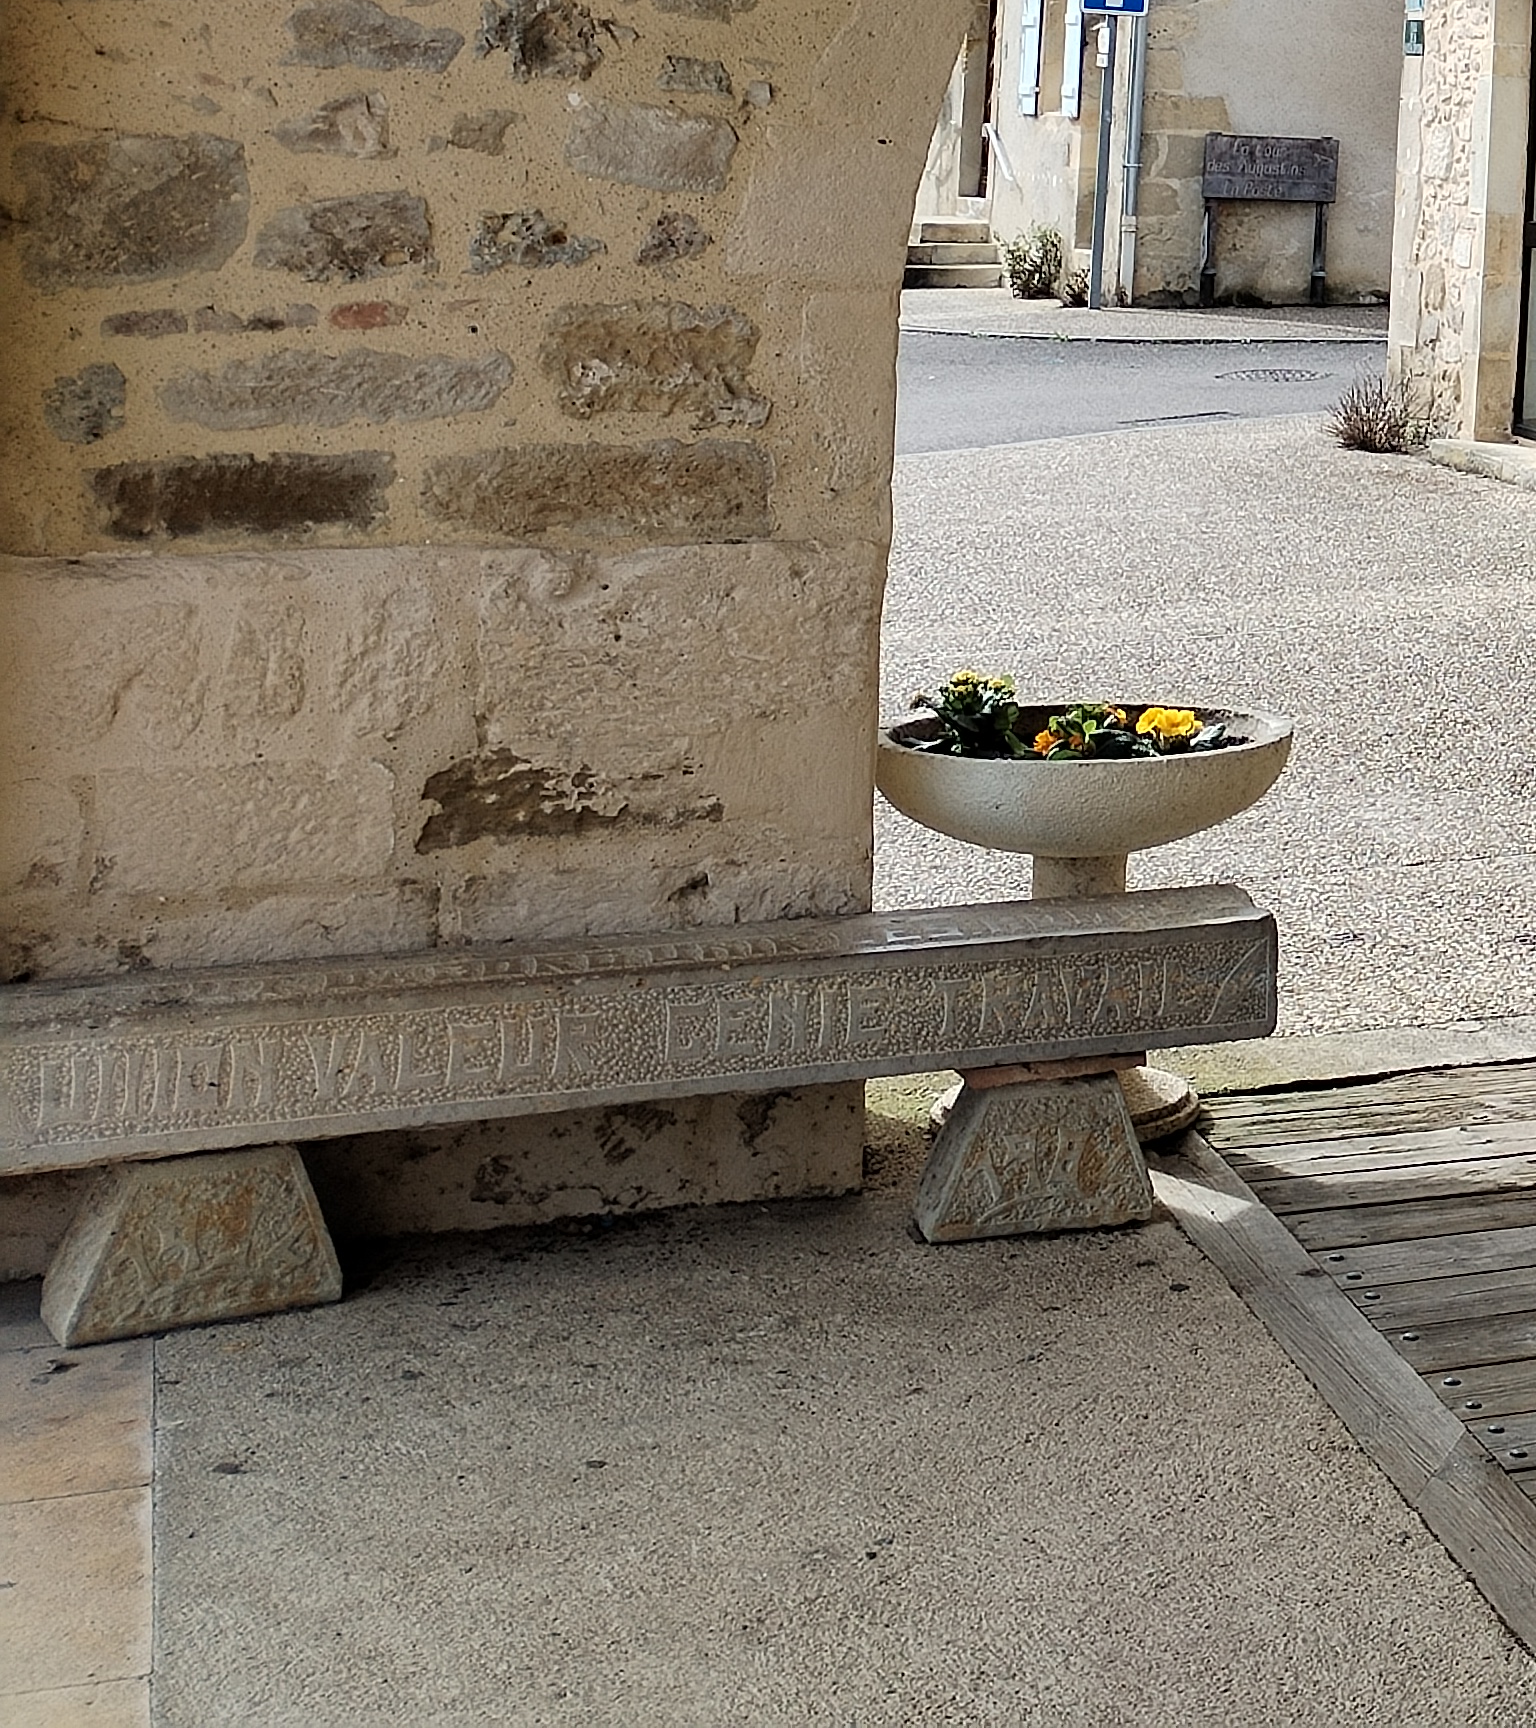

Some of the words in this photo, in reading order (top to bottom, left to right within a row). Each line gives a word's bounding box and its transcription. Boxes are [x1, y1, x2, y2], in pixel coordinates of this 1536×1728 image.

[1206, 158, 1231, 173] des
[1237, 159, 1307, 178] Augustins
[37, 1040, 282, 1129] UNION
[305, 1012, 603, 1101] VALEUR
[663, 982, 890, 1063] GENIE
[930, 957, 1196, 1037] TRAVAIL
